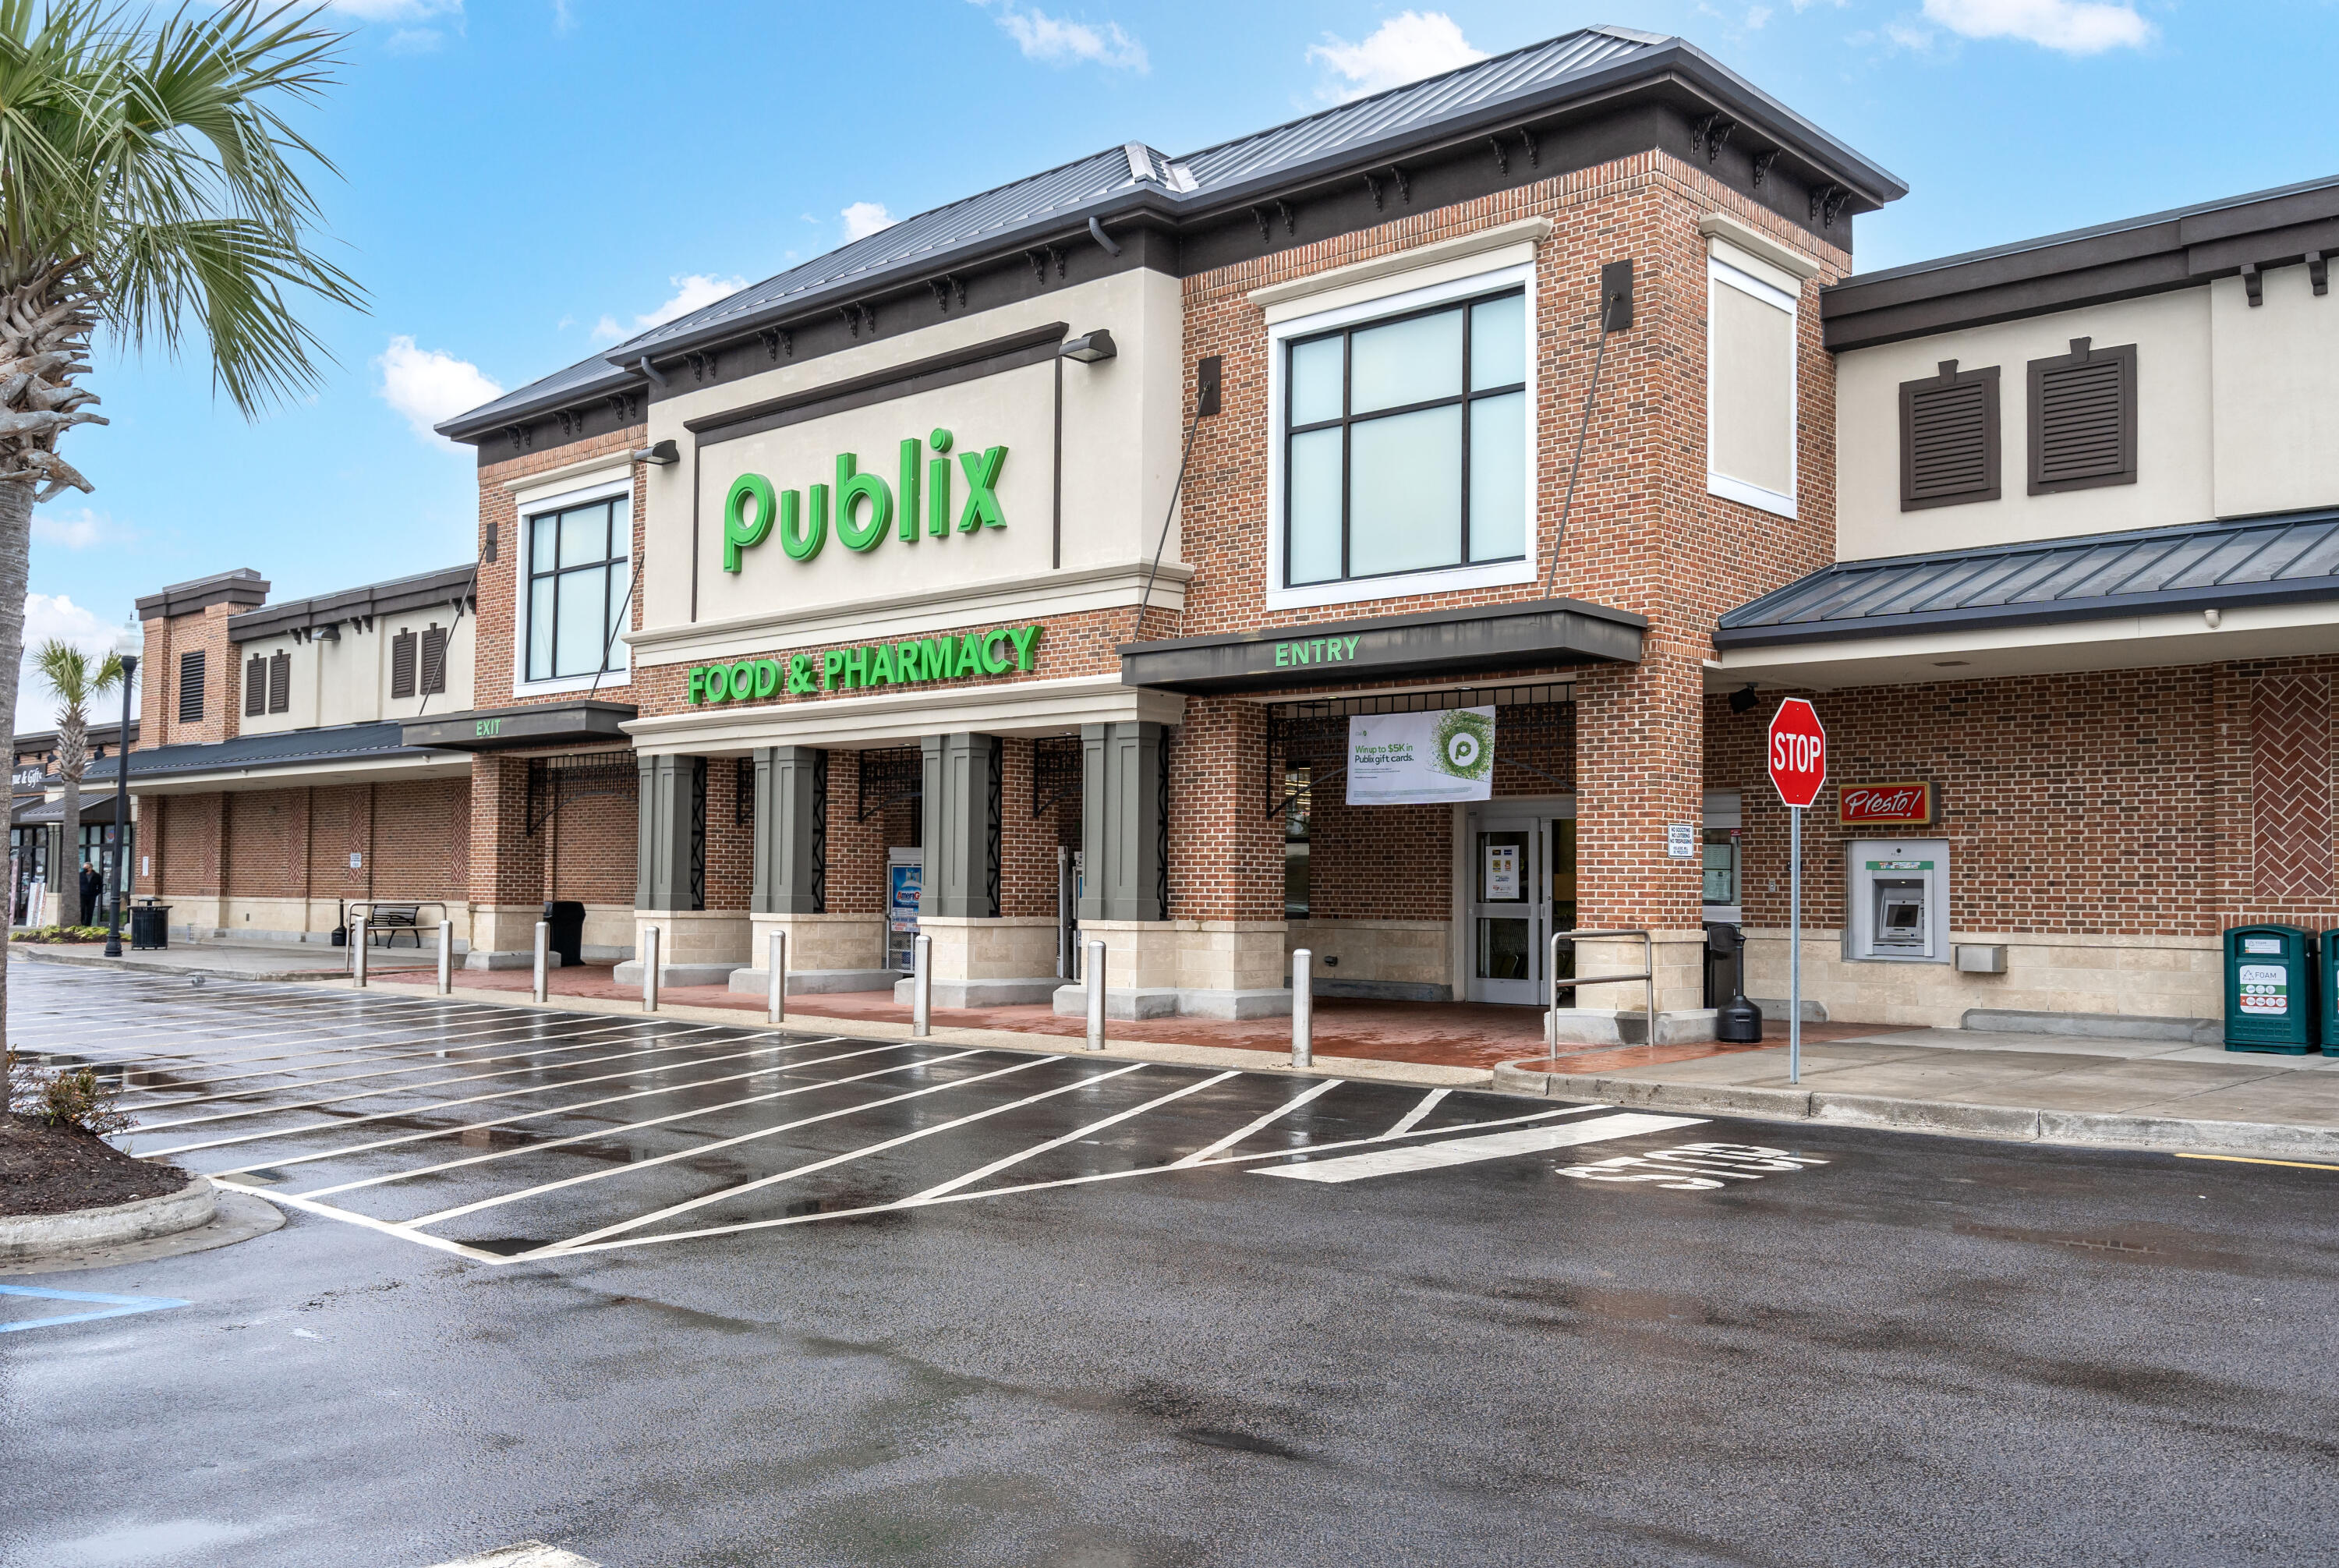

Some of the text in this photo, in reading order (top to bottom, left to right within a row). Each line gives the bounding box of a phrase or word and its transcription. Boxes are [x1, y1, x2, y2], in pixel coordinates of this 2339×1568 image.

[724, 427, 1009, 573] Publix
[1276, 635, 1361, 667] ENTRY
[688, 625, 1045, 705] FOOD & PHARMACY
[476, 718, 501, 736] EXIT
[1375, 754, 1389, 765] gift
[1391, 753, 1414, 763] cards.
[1388, 743, 1405, 753] $5K
[1406, 743, 1414, 752] in
[1774, 731, 1821, 773] STOP
[22, 770, 27, 784] &
[1845, 790, 1922, 817] Presto!
[897, 891, 922, 900] AmeriG
[1555, 1142, 1831, 1190] STOP
